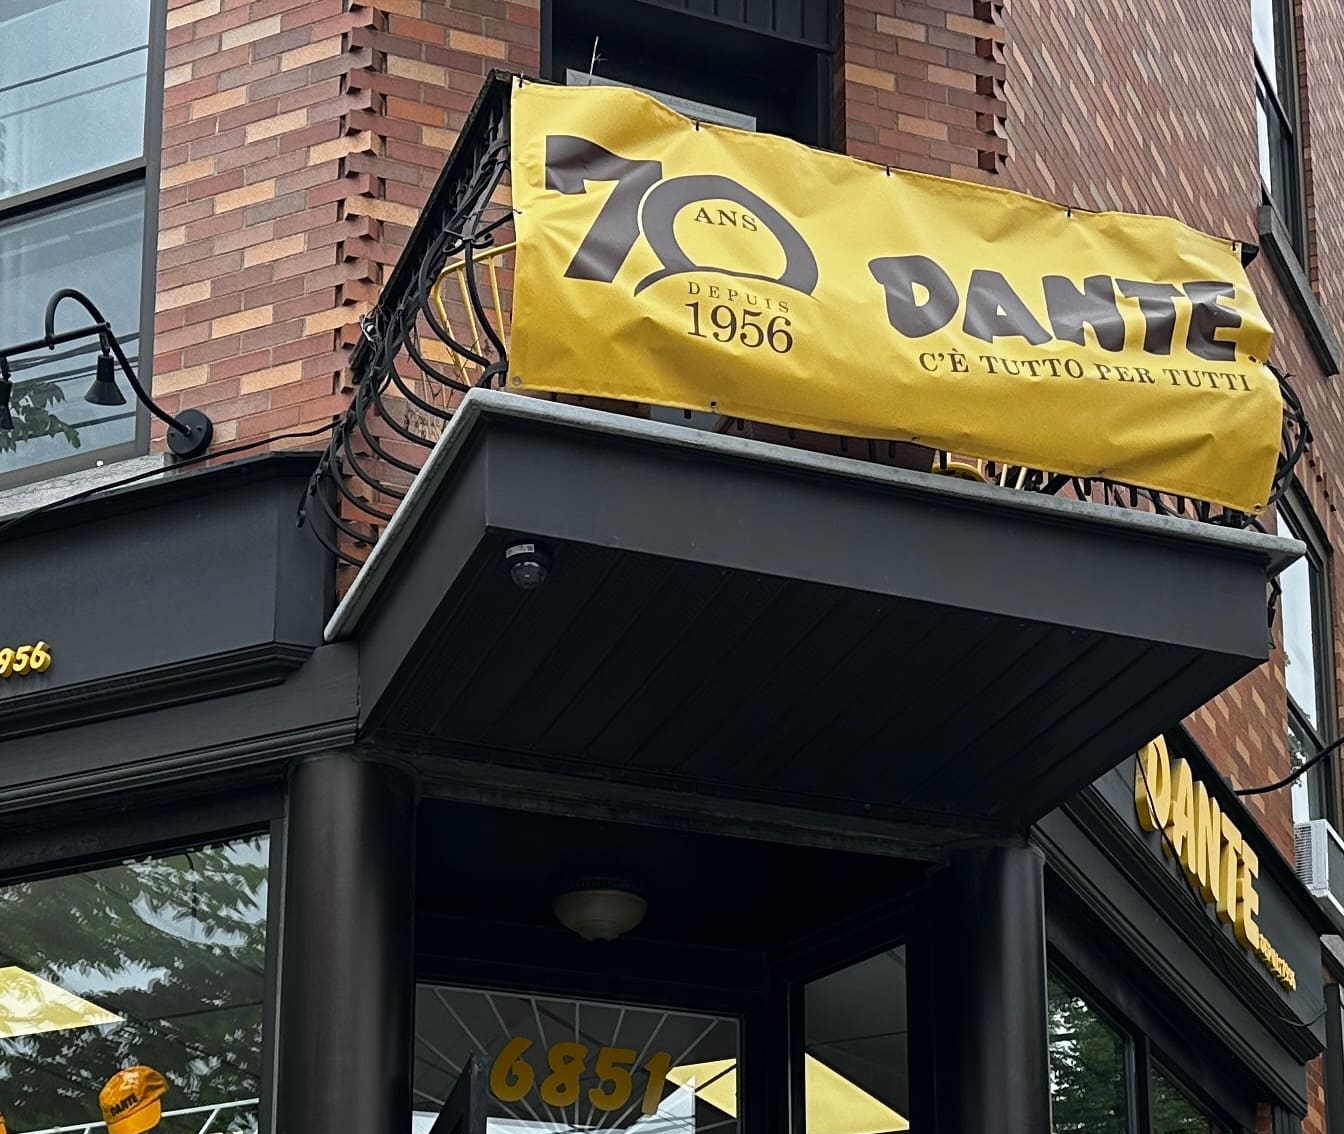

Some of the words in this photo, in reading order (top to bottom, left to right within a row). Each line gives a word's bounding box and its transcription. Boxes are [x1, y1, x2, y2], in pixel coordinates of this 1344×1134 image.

[544, 134, 821, 297] 70
[693, 206, 760, 233] ANS
[687, 280, 791, 314] DEPUIS
[868, 255, 1244, 362] DANTE
[686, 301, 794, 355] 1956
[979, 355, 1086, 381] TUTTO
[1095, 364, 1156, 387] PER
[1162, 369, 1253, 392] TUTTI
[490, 1037, 672, 1115] 6851
